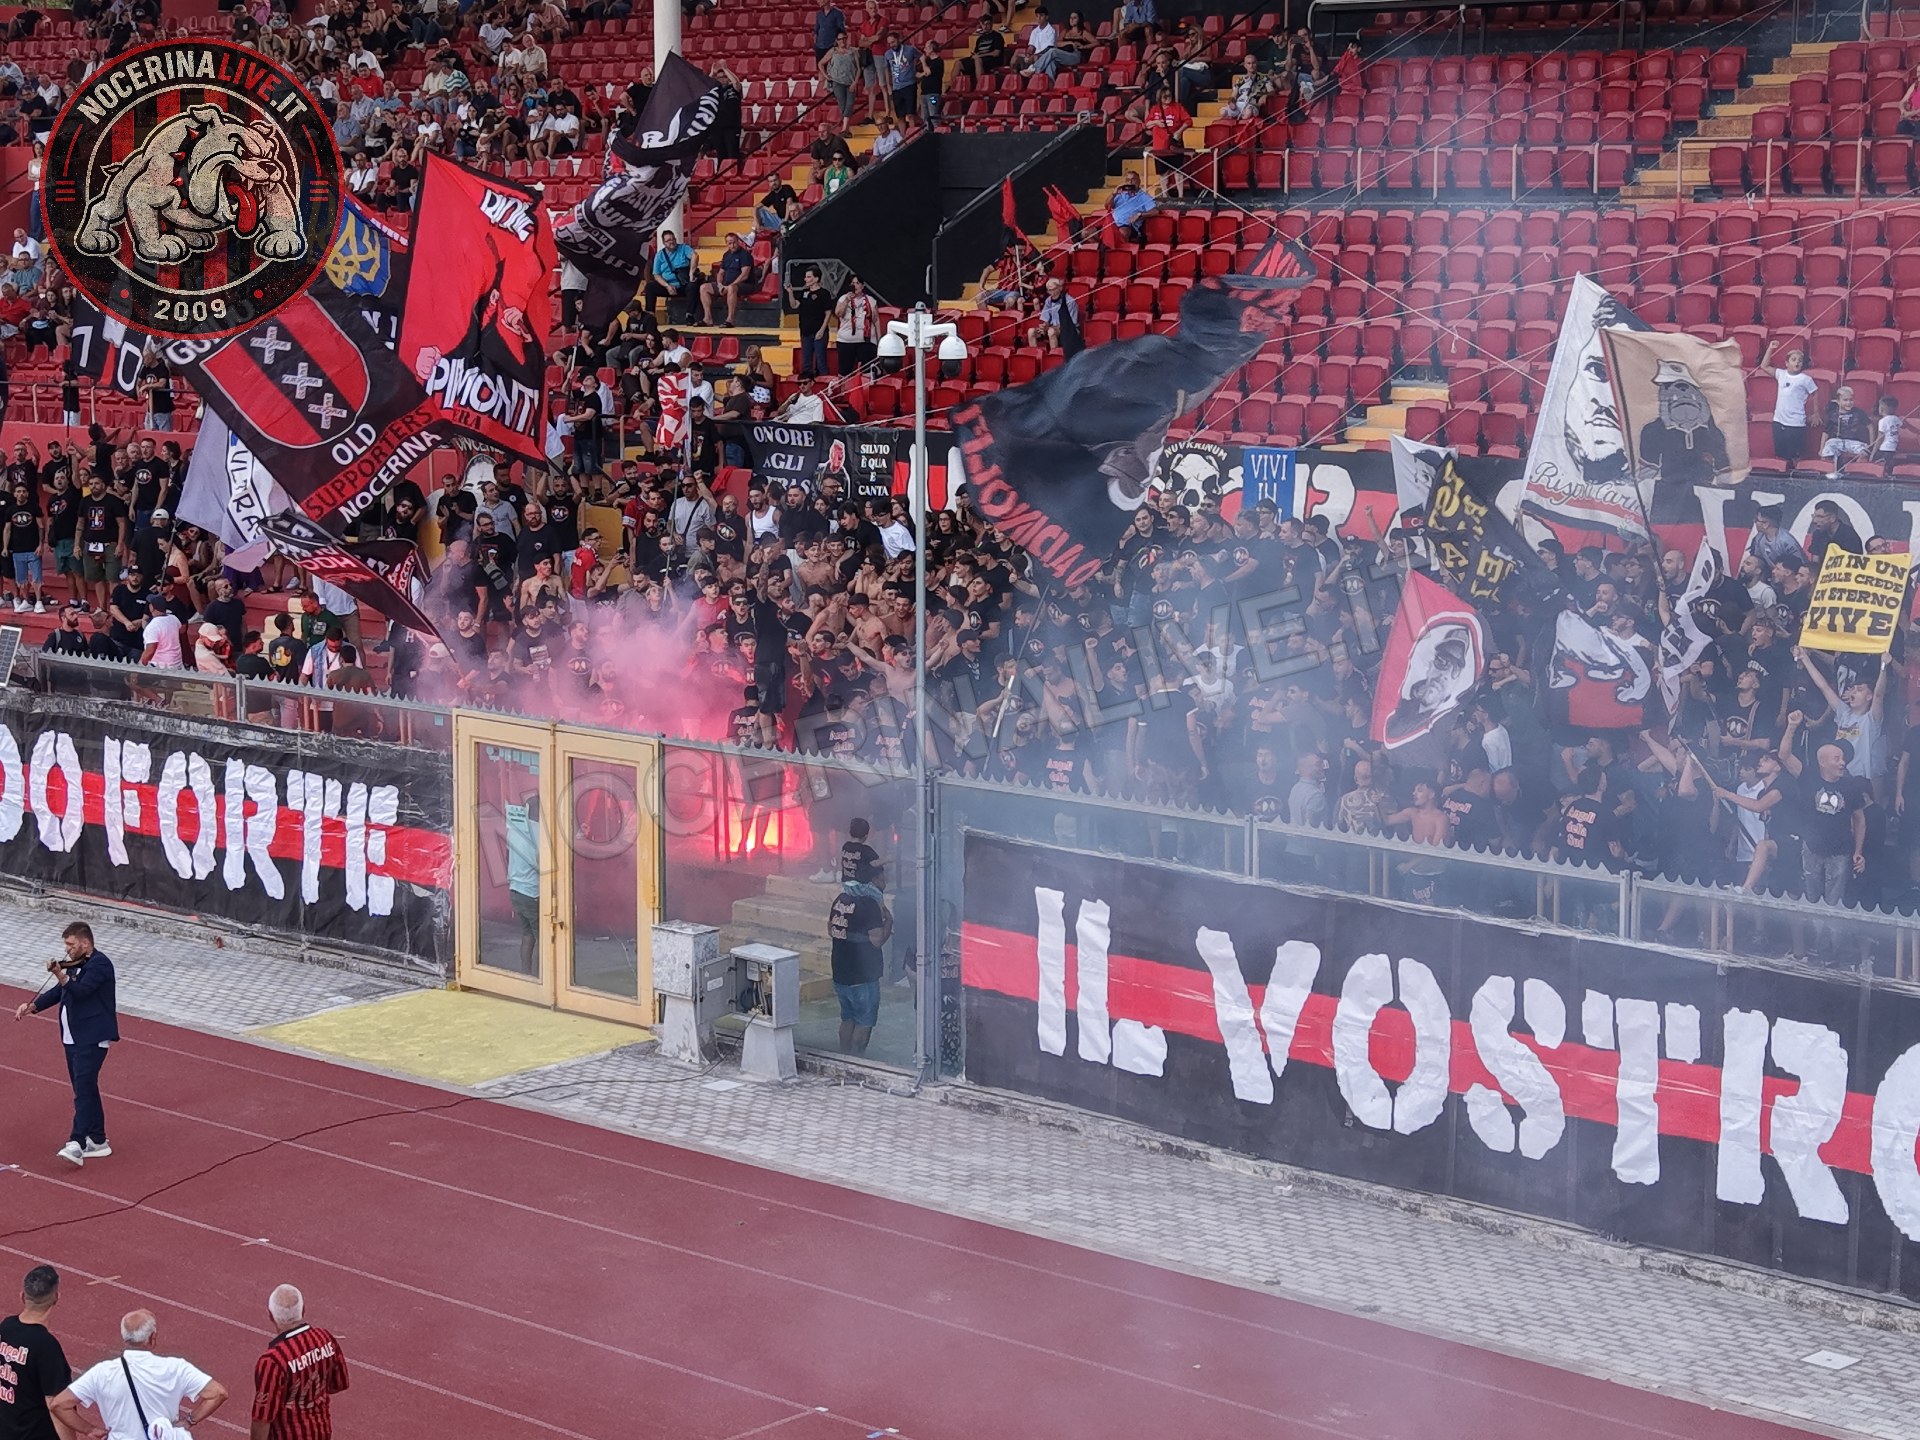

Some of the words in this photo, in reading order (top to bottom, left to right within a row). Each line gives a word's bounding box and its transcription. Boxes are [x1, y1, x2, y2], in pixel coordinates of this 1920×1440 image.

[331, 423, 377, 466] OLD
[753, 425, 815, 447] ONORE
[860, 443, 890, 455] SILVIO
[304, 406, 434, 517] SUPPORTERS
[762, 452, 805, 472] AGLI
[868, 457, 887, 469] QUA
[1251, 454, 1288, 481] VIVI
[337, 429, 443, 524] NOCERINA
[870, 471, 876, 483] E
[229, 450, 262, 541] ULTRA
[858, 485, 889, 497] CANTA
[1825, 554, 1845, 571] CHI
[1846, 554, 1871, 571] IN
[1875, 559, 1908, 581] UN
[1854, 573, 1904, 594] CREDE
[1813, 588, 1828, 602] IN
[1828, 587, 1901, 610] ETERNO
[1807, 606, 1894, 637] VIVE
[103, 735, 400, 918] FORTE
[1567, 806, 1597, 825] Angeli
[1566, 820, 1588, 838] della
[1566, 833, 1585, 850] Sud
[1033, 885, 1168, 1078] IL
[0, 1341, 29, 1366] ngeli
[287, 1341, 336, 1374] VERTICALE
[0, 1363, 18, 1386] ella
[0, 1384, 15, 1405] ud
